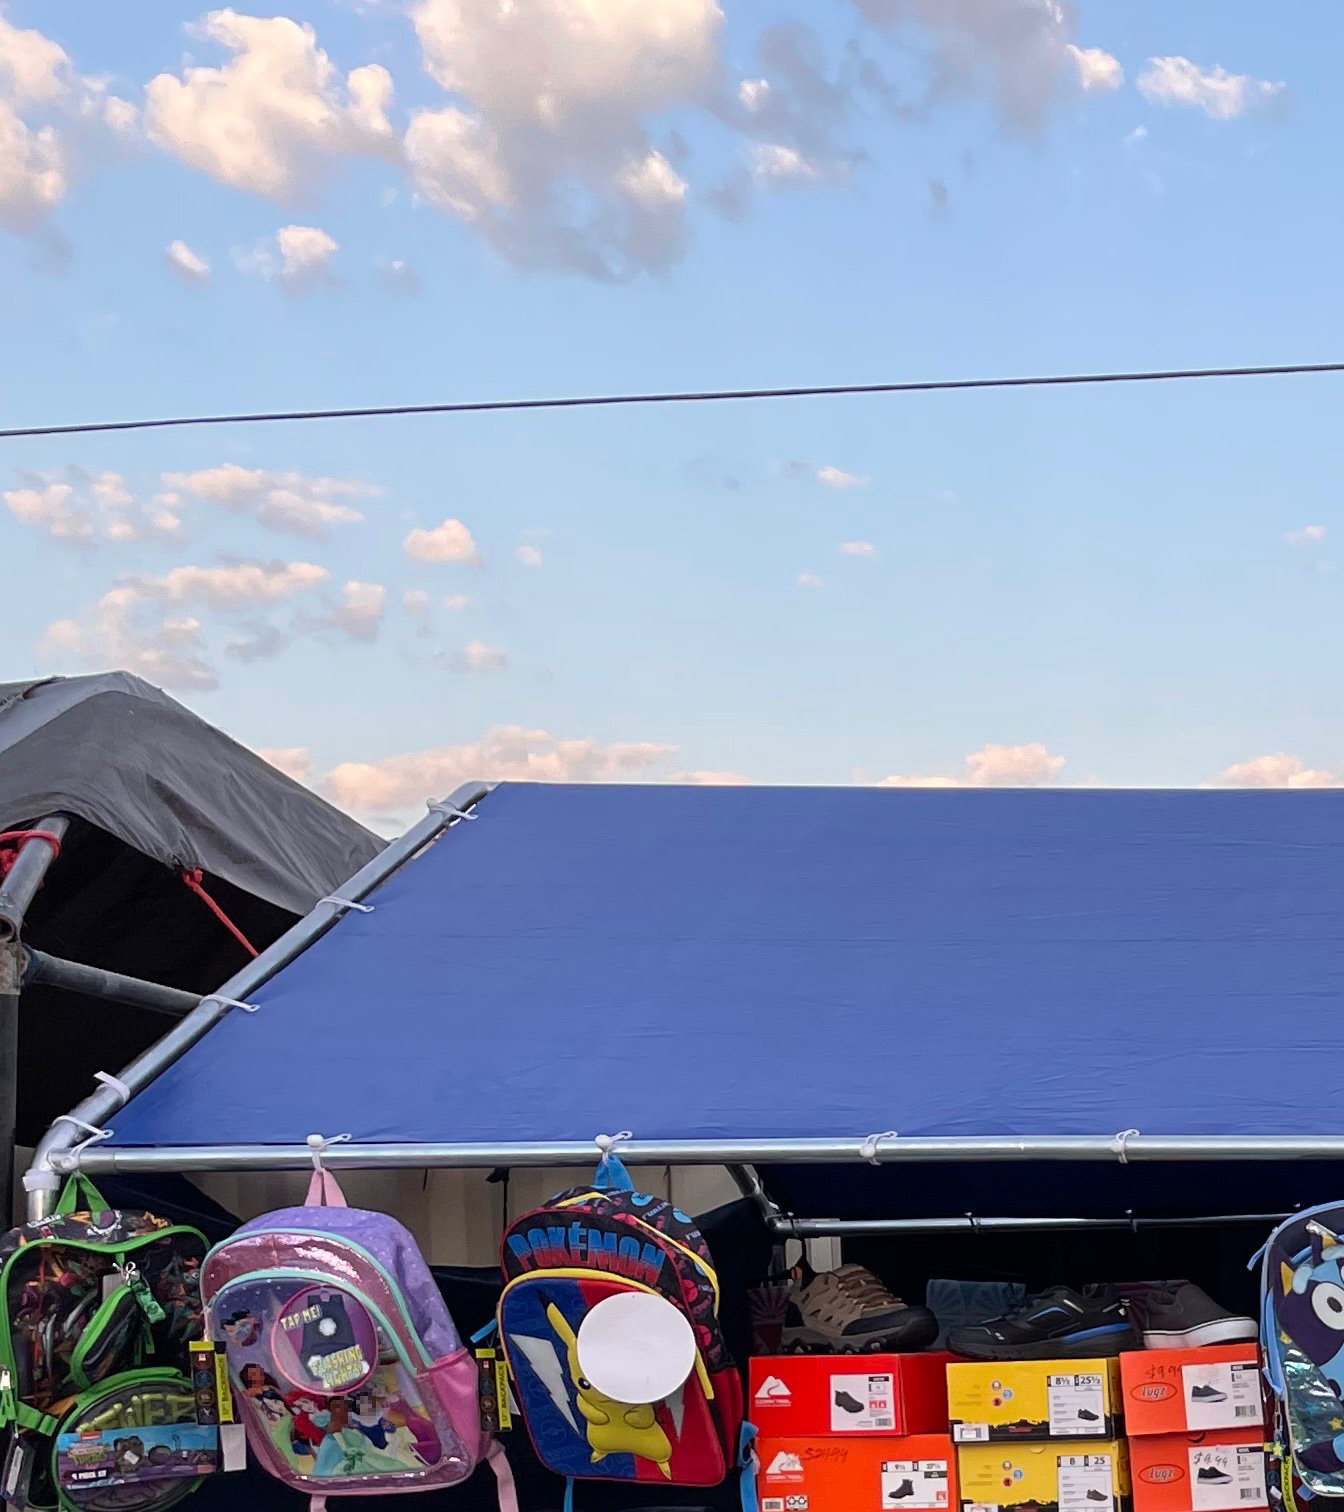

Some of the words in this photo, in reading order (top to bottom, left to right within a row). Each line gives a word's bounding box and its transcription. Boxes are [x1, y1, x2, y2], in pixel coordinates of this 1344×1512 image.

[507, 1221, 665, 1285] POKÉMON
[281, 1313, 302, 1331] TAP
[1094, 1457, 1105, 1465] 25
